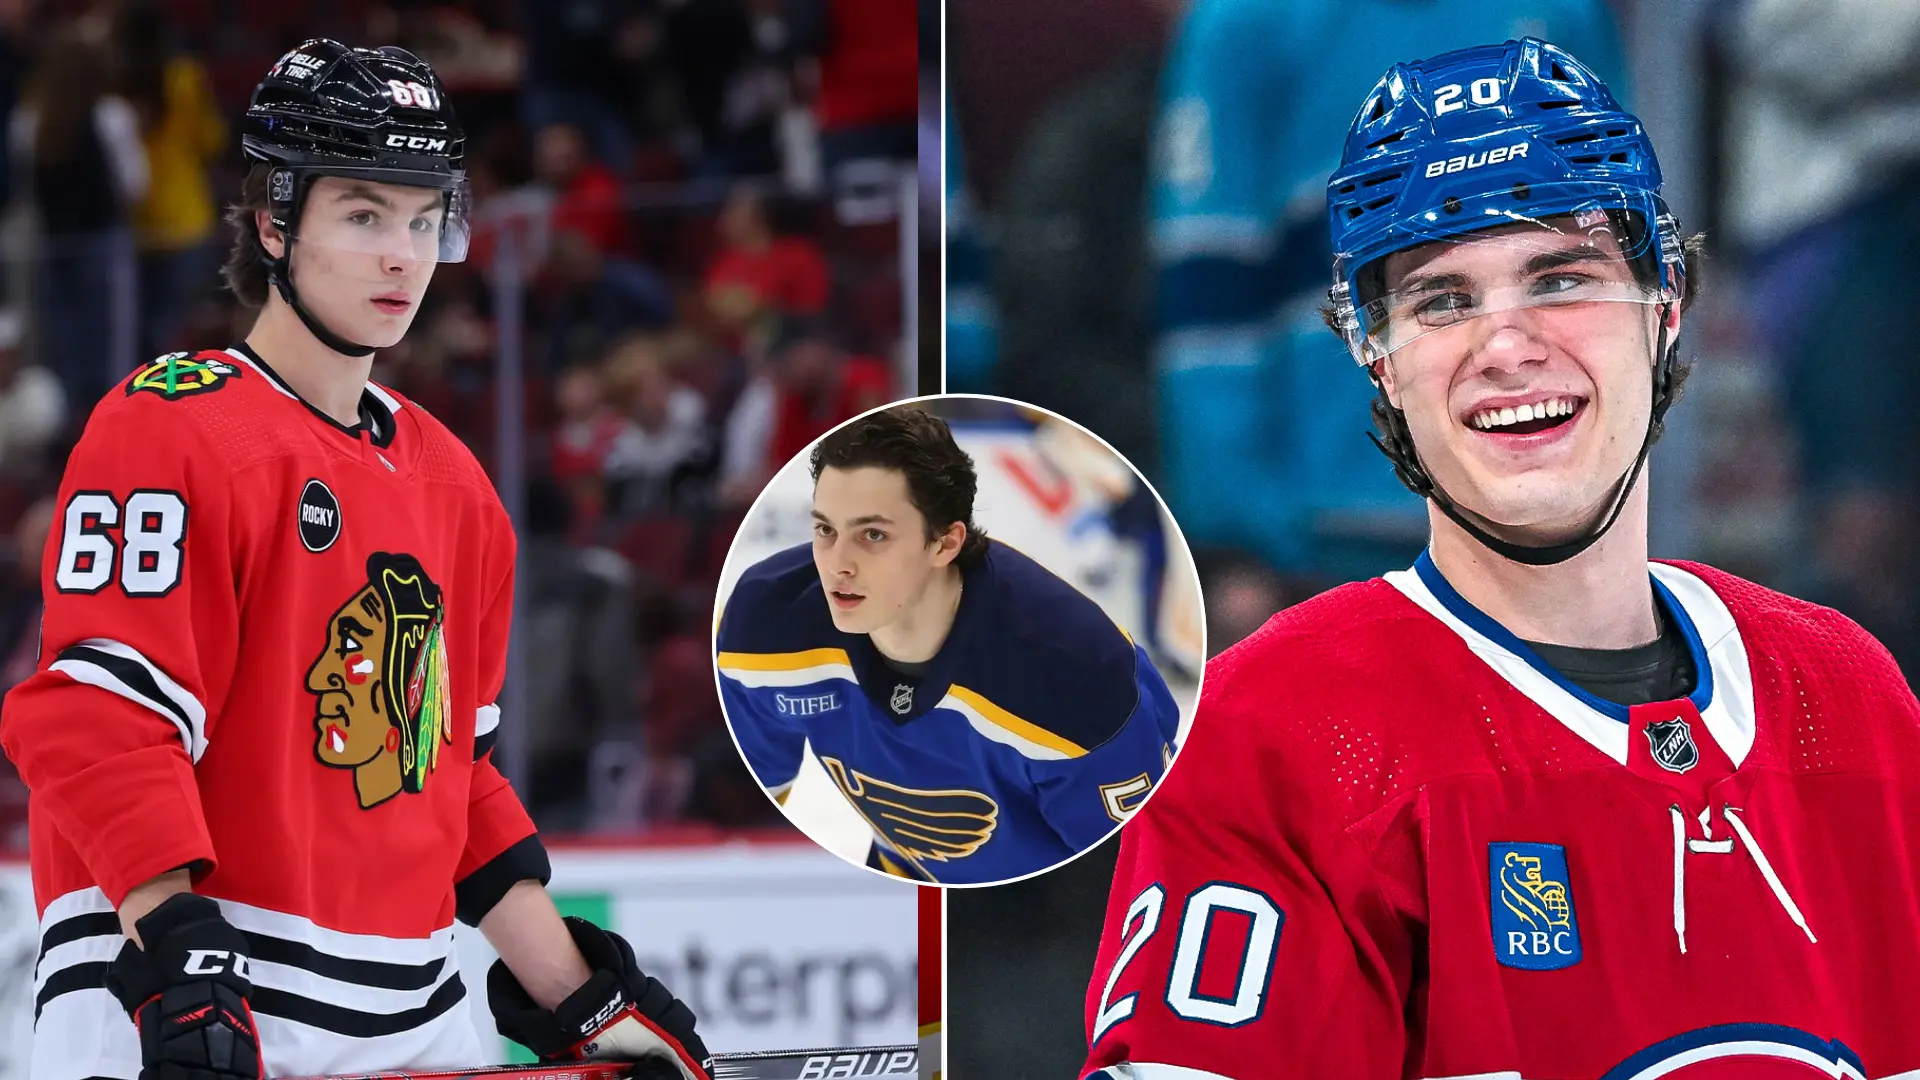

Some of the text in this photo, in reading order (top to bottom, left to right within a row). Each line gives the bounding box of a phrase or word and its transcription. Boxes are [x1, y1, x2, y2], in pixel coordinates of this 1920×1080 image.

[290, 53, 326, 70] BELLE
[1434, 78, 1503, 116] 20
[386, 134, 447, 151] CCM
[302, 504, 334, 528] ROCKY
[55, 489, 189, 597] 68
[776, 693, 842, 715] STIFEL
[1661, 729, 1685, 762] LNH
[1507, 931, 1572, 955] RBC
[1092, 879, 1286, 1049] 20
[580, 990, 622, 1033] CCM
